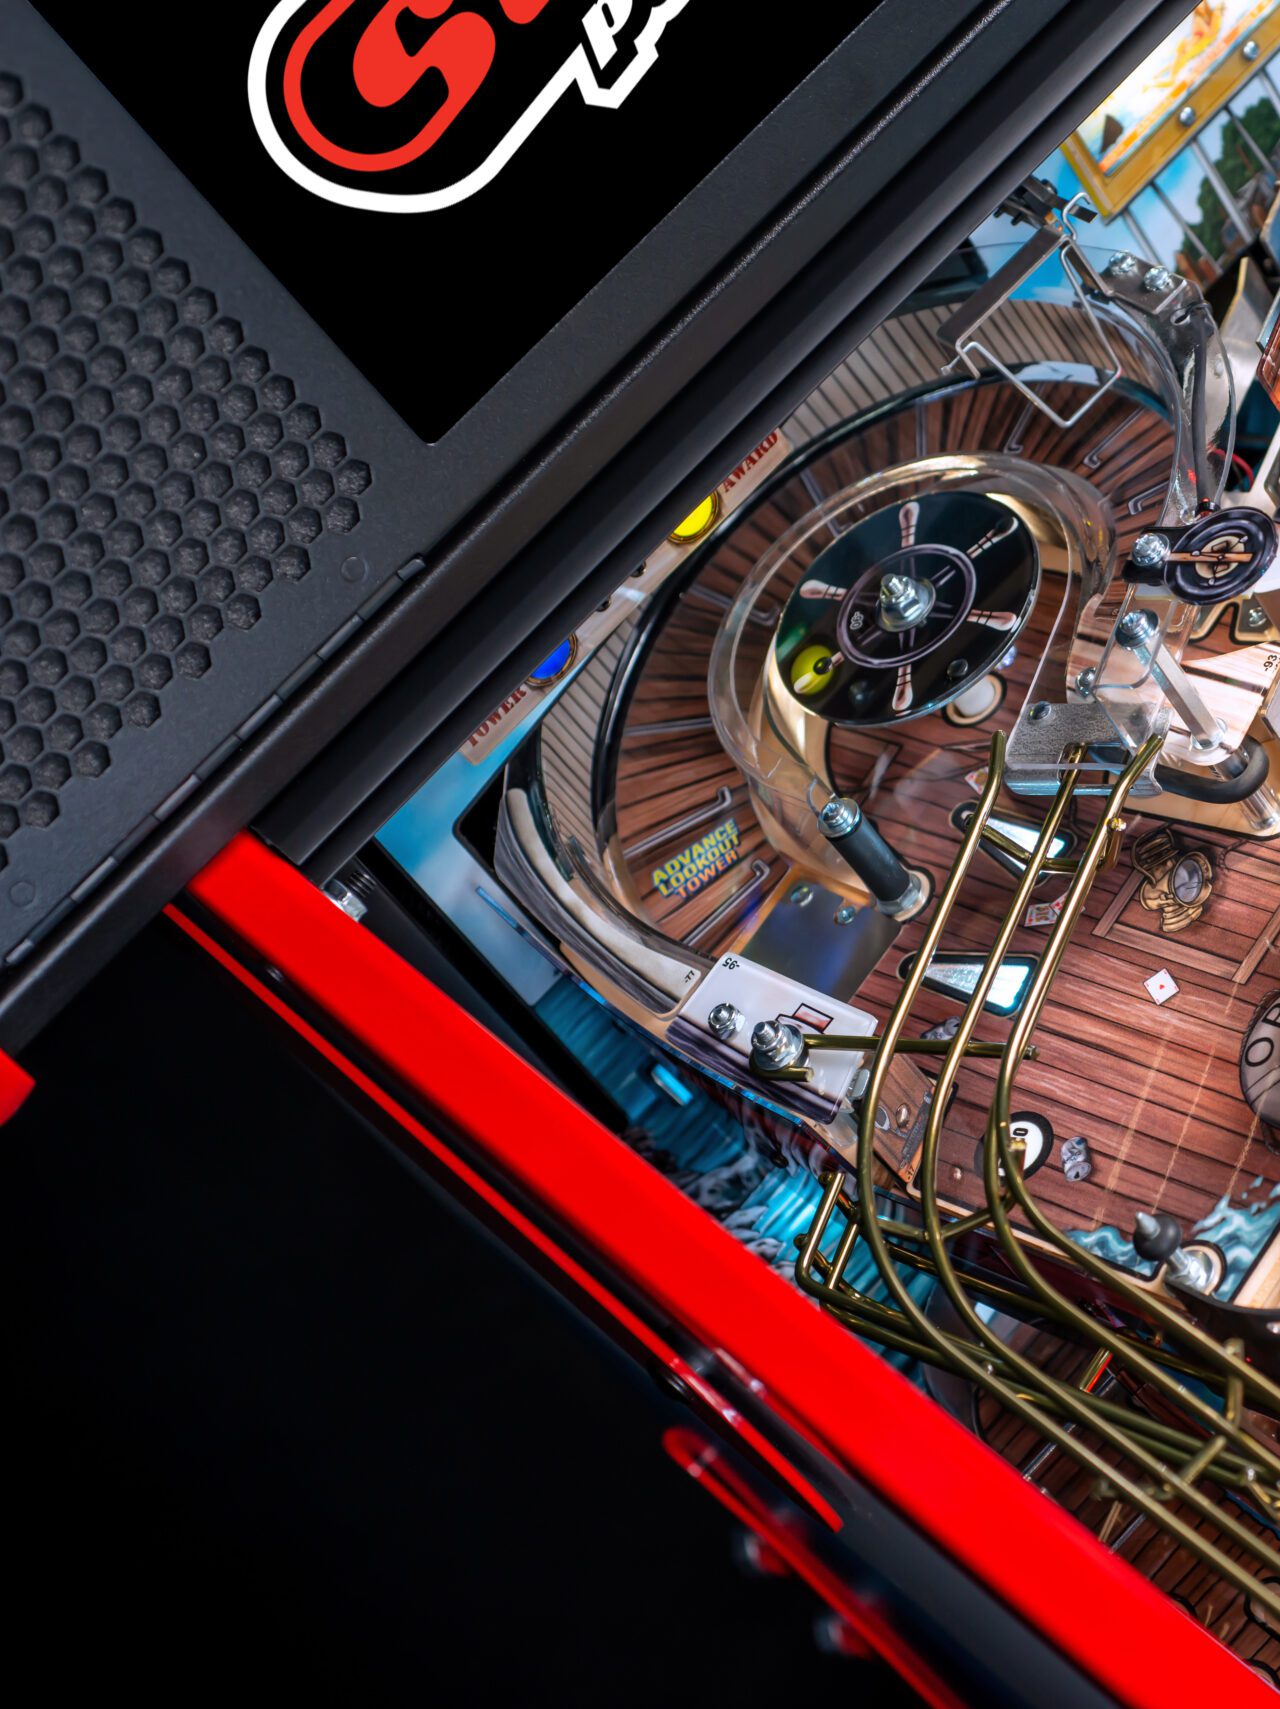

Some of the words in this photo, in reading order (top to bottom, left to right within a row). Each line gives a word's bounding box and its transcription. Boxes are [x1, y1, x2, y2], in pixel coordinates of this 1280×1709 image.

[723, 432, 777, 493] AWARD
[1263, 654, 1278, 672] -93
[469, 688, 527, 747] TOWER
[653, 818, 738, 887] ADVANCE
[659, 833, 739, 897] LOOKOUT
[677, 850, 737, 898] TOWER
[721, 956, 741, 970] -95
